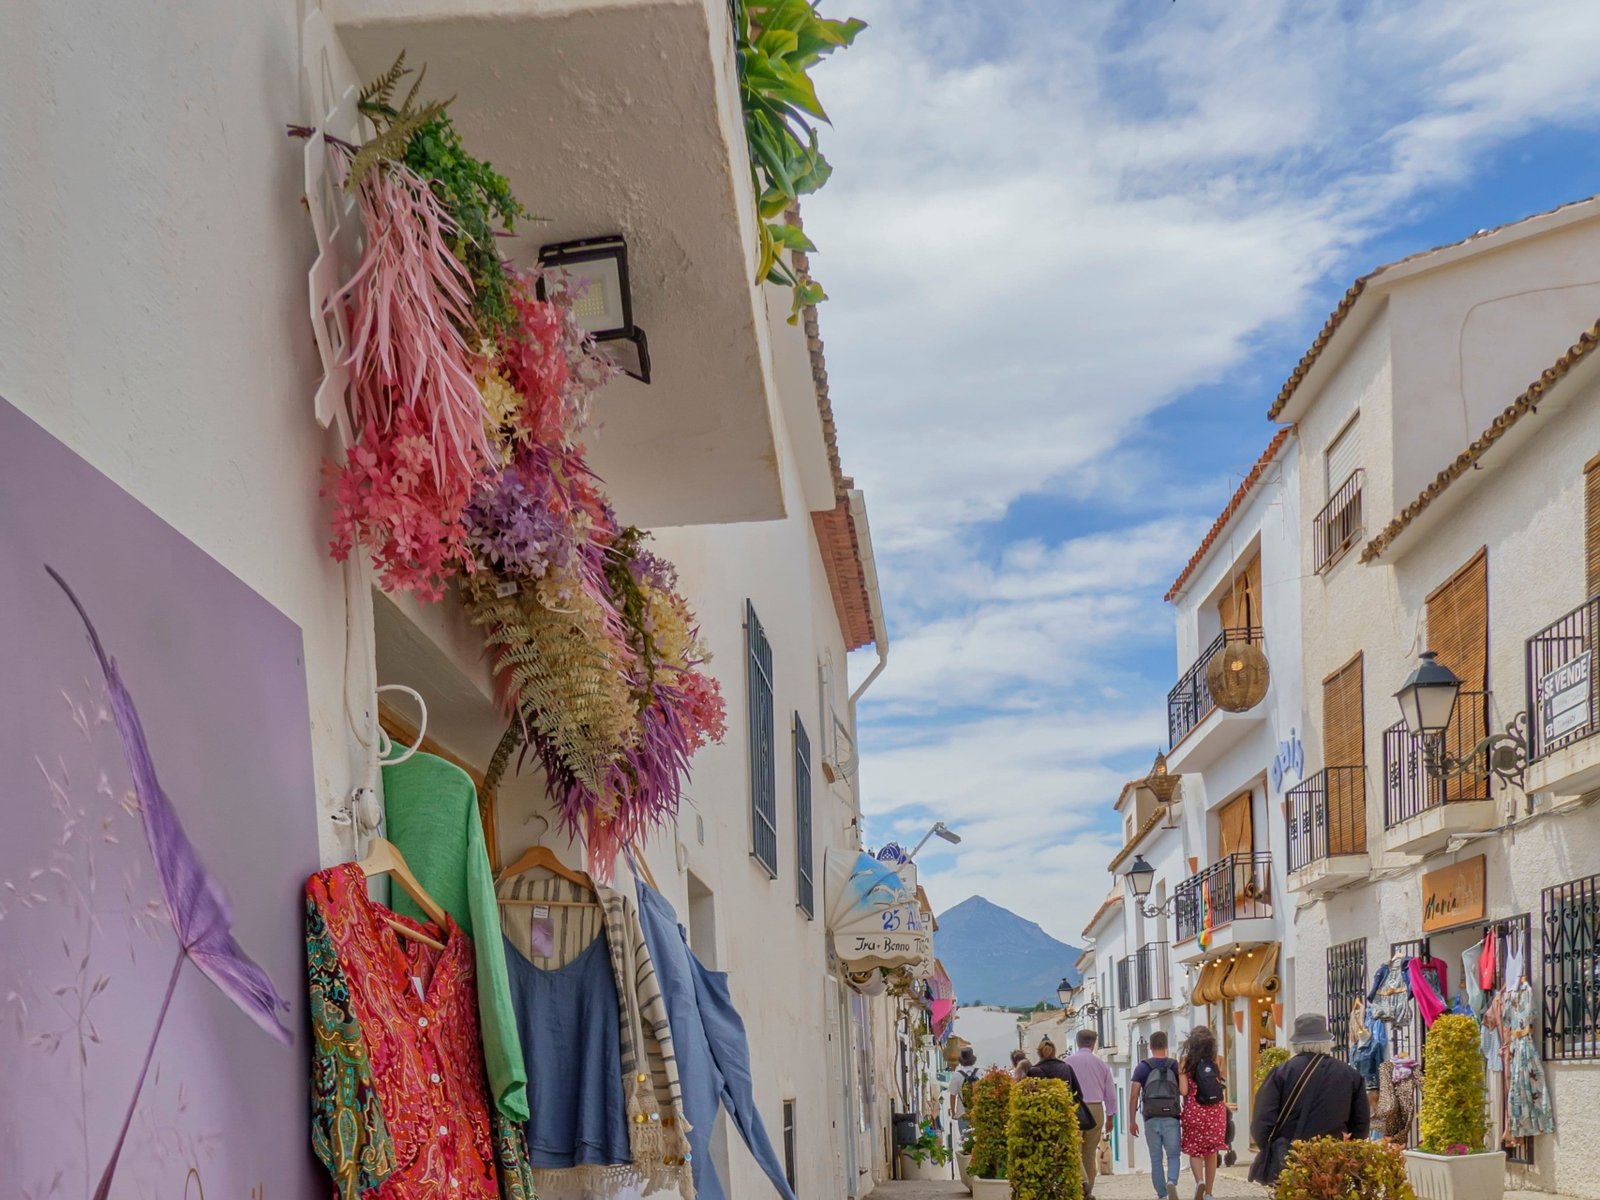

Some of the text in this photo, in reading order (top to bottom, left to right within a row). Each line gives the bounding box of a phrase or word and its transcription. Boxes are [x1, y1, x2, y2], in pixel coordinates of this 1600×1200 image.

[1545, 659, 1587, 701] SE VENDE
[882, 909, 900, 932] 25
